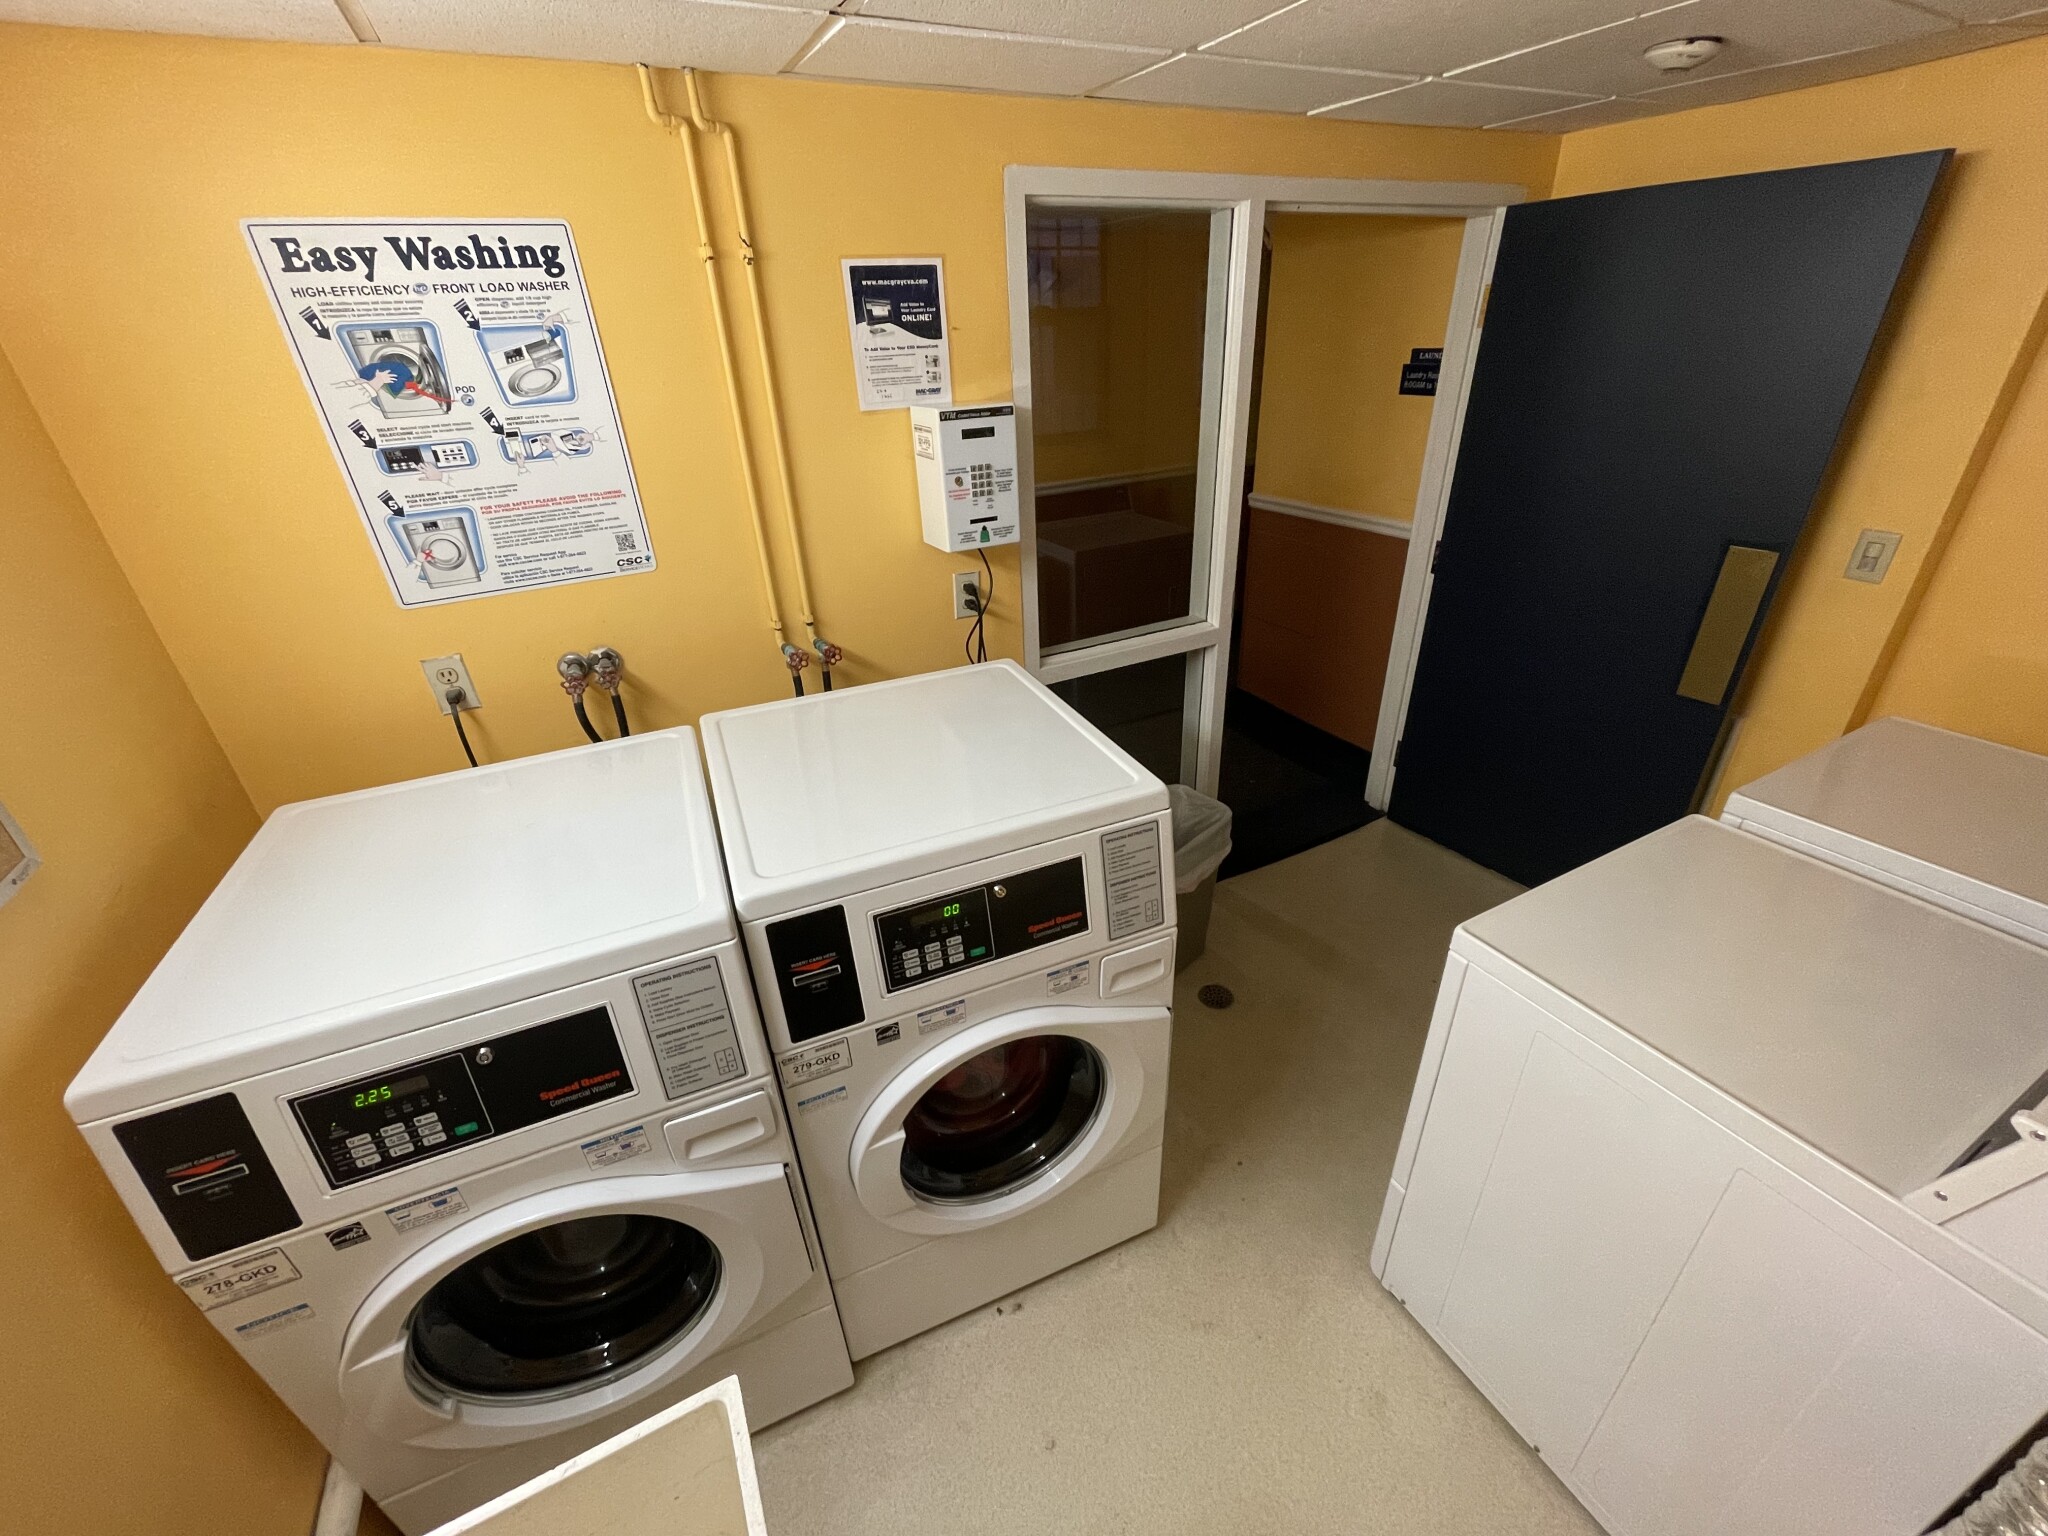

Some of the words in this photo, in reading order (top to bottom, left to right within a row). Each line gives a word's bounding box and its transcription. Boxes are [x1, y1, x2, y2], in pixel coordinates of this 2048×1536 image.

[270, 237, 378, 282] Easy
[383, 234, 566, 278] Washing
[290, 285, 410, 298] HIGH-EFFICIENCY
[432, 283, 475, 294] FRONT
[479, 282, 515, 293] LOAD
[516, 281, 570, 292] WASHER
[311, 318, 322, 330] 1
[463, 310, 475, 322] 2
[901, 314, 932, 322] ONLINE!
[455, 386, 476, 394] POD
[489, 417, 499, 427] 4
[358, 430, 370, 441] 3
[589, 489, 622, 497] FOLLOWING
[388, 501, 399, 510] 5
[617, 556, 643, 567] CSC
[1028, 918, 1055, 933] Speed
[1055, 911, 1082, 924] Queen
[640, 976, 672, 988] OPERATING
[672, 964, 712, 979] INSTRUCTIONS
[656, 1026, 687, 1039] DISPENSER
[687, 1014, 725, 1030] INSTRUCTIONS
[793, 1052, 840, 1073] 279-GKD
[539, 1081, 580, 1101] Speed
[581, 1070, 620, 1087] Queen
[549, 1088, 591, 1107] Commercial
[591, 1081, 617, 1094] Washer
[354, 1086, 392, 1108] 2.25
[203, 1265, 277, 1295] 278-GKD
